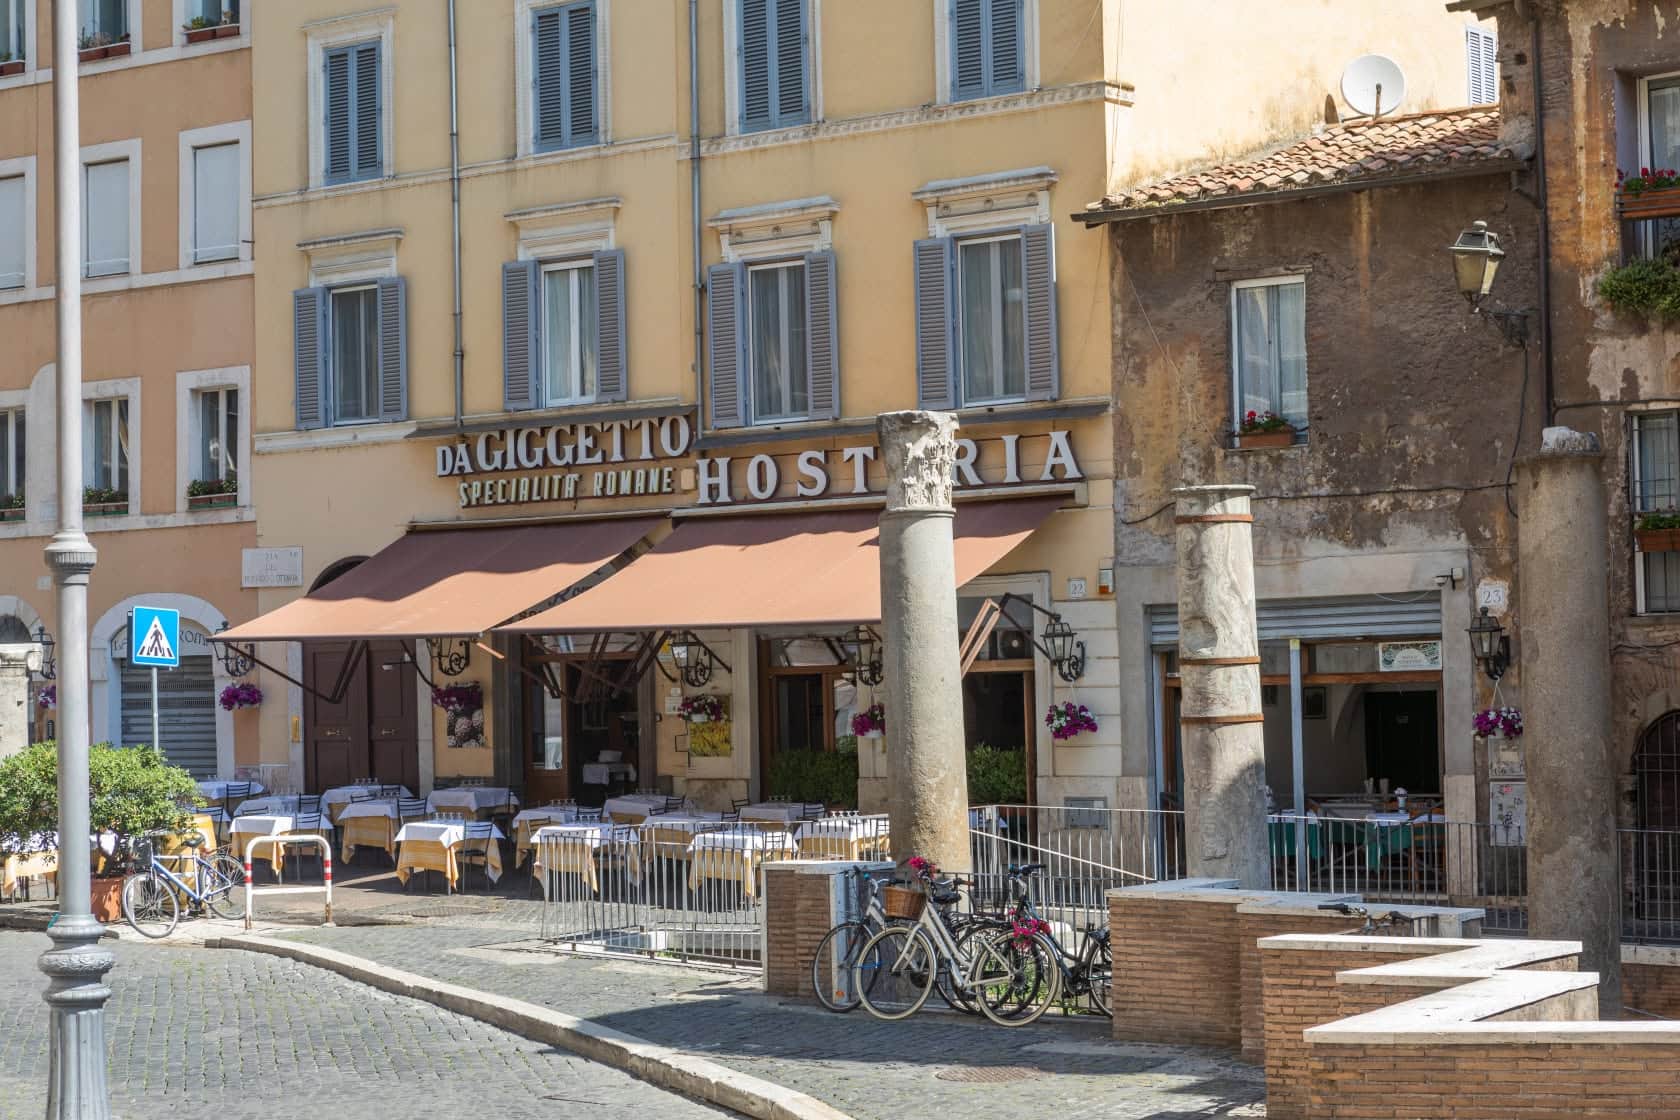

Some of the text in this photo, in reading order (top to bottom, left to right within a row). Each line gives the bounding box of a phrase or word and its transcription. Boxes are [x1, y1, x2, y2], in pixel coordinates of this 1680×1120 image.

[436, 415, 690, 476] DA GIGGETTO
[696, 430, 1083, 504] HOSTRIA
[593, 466, 673, 497] ROMANE
[1482, 590, 1502, 603] 23
